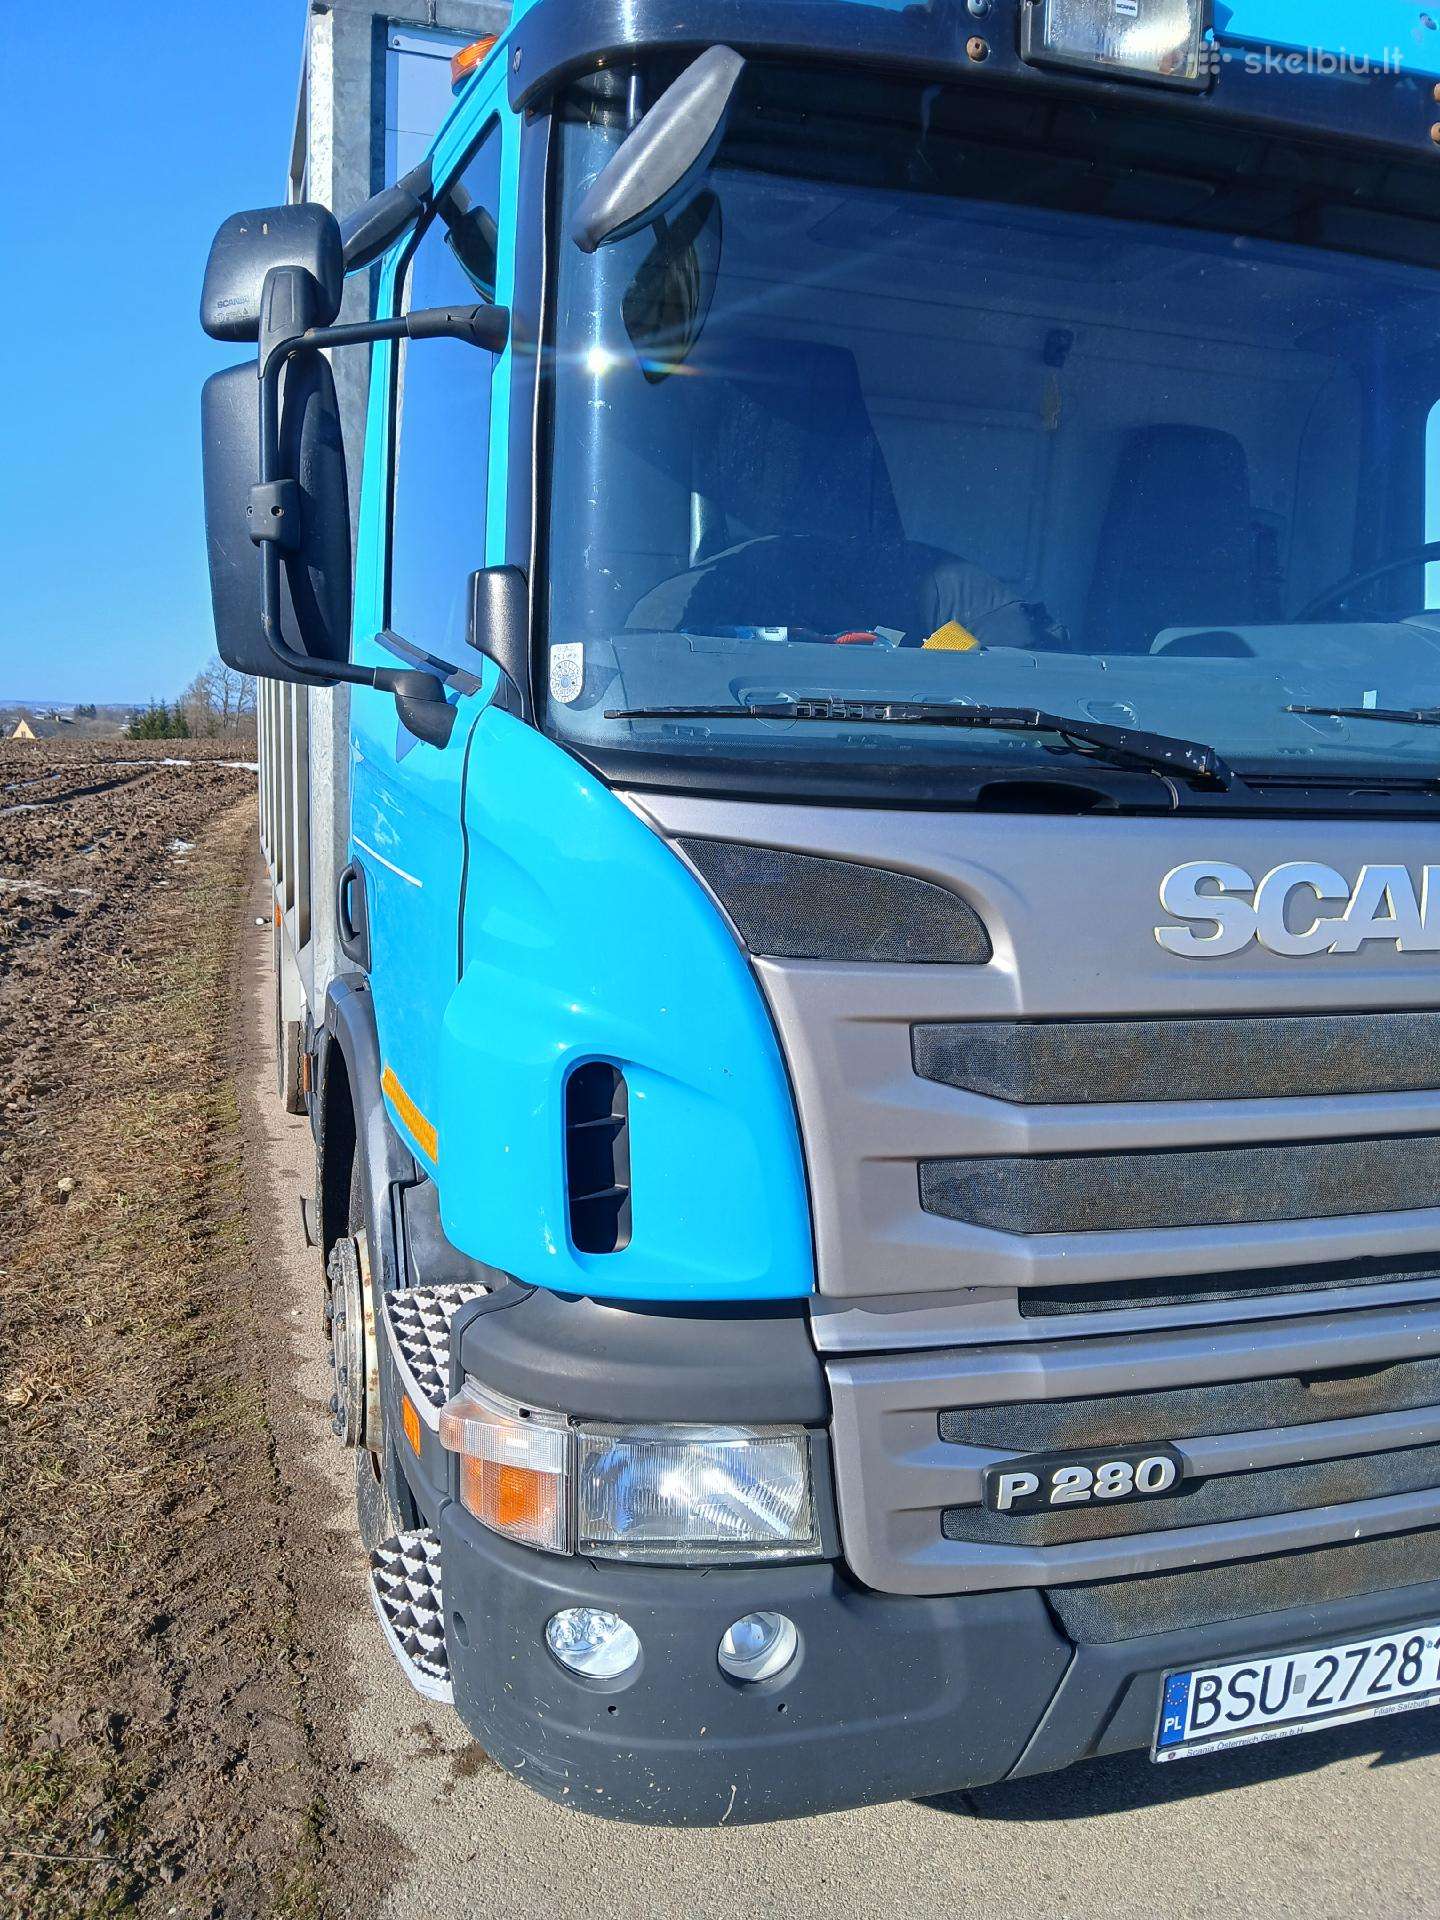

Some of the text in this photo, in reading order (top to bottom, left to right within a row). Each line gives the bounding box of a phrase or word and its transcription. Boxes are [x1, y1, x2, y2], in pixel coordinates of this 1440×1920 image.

[997, 1456, 1176, 1510] P 280
[1189, 1660, 1295, 1731] BSU
[1163, 1715, 1182, 1733] PL
